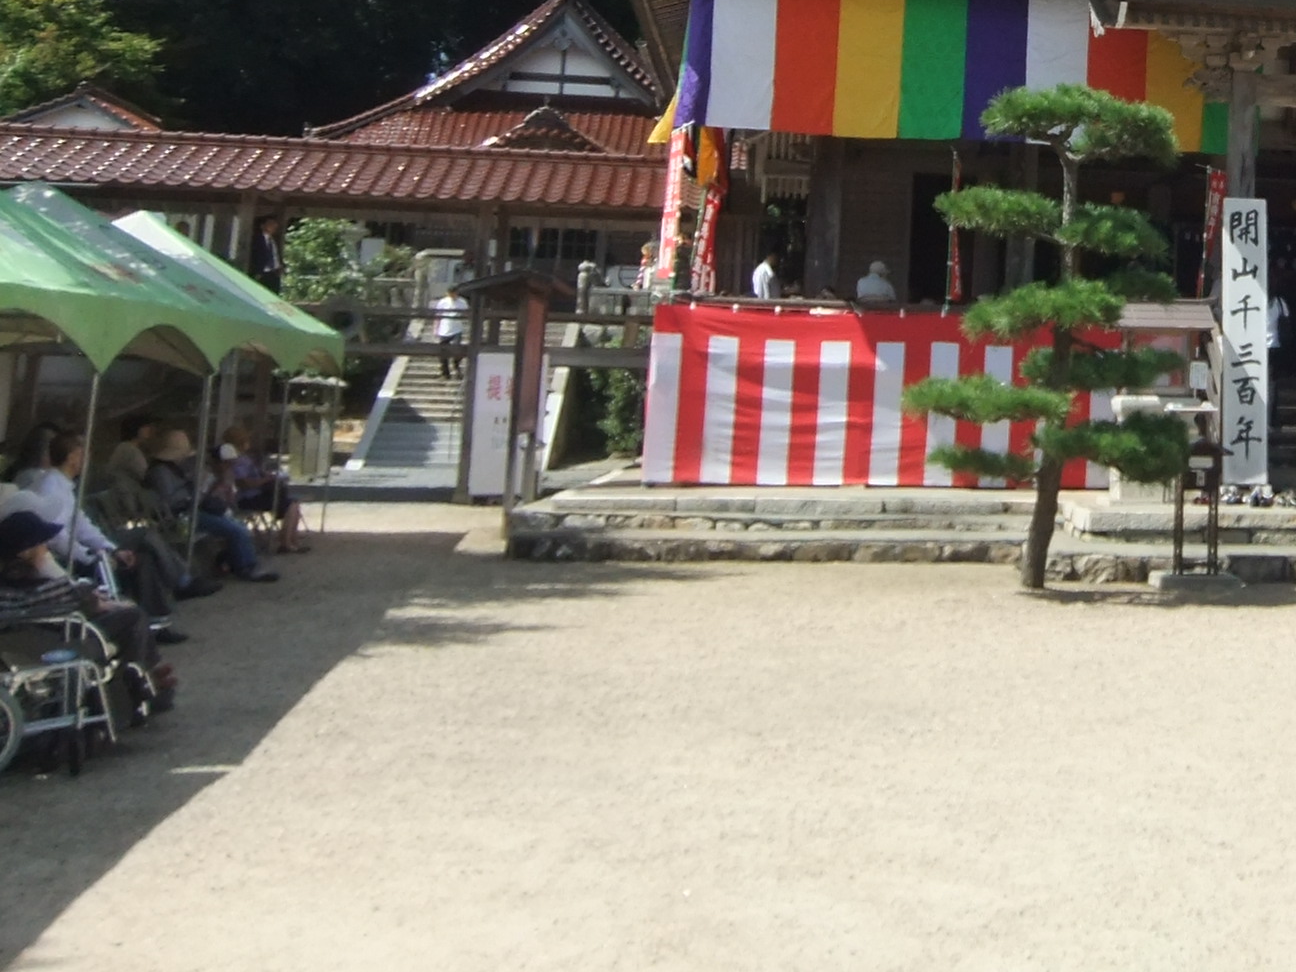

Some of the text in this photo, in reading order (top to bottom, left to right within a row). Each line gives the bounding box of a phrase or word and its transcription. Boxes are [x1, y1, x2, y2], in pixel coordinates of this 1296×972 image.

[1229, 209, 1262, 461] 開山千三百年
